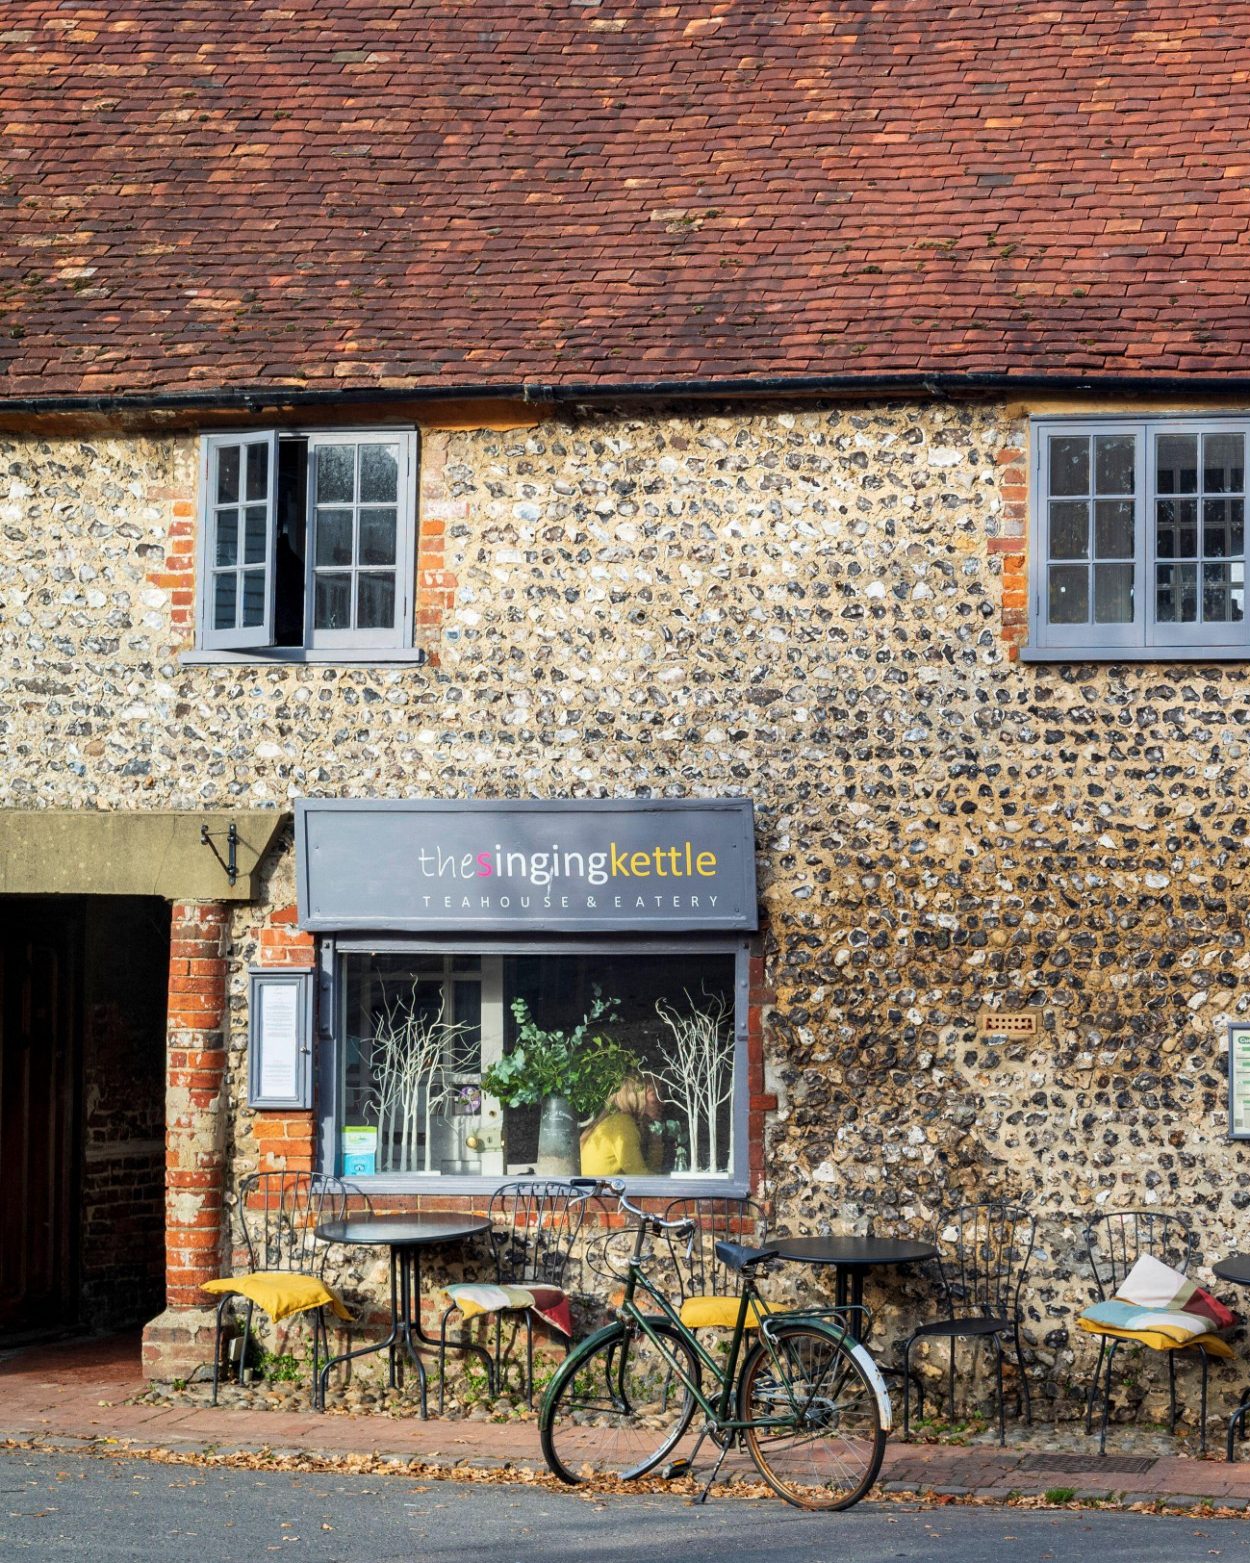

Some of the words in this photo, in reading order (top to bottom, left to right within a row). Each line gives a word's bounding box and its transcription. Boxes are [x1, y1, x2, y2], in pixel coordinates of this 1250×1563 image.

[423, 896, 569, 908] TEAHOUSE
[587, 896, 597, 908] &
[615, 895, 718, 908] EATERY
